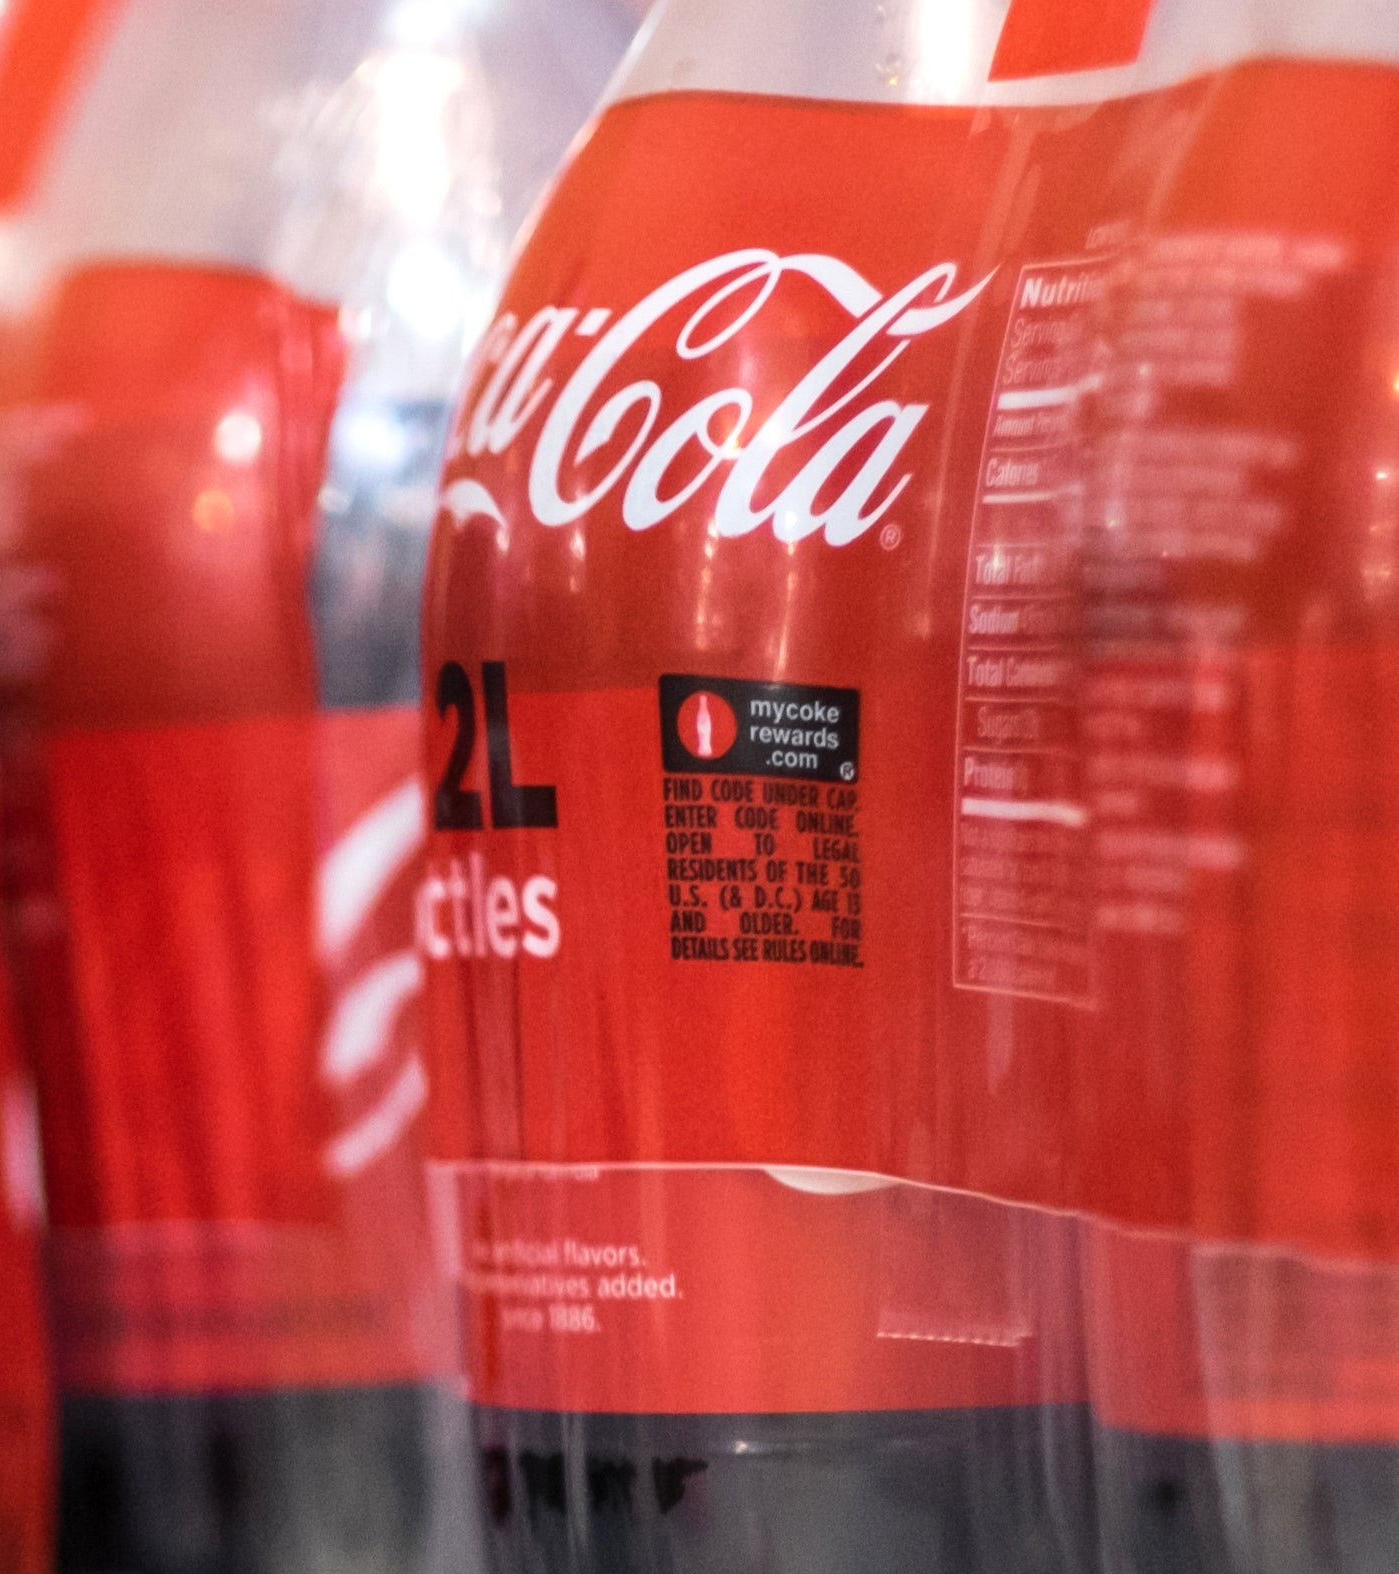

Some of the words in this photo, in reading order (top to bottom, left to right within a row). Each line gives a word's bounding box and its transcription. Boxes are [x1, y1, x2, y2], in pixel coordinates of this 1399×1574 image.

[749, 699, 841, 724] mycoke
[433, 659, 559, 833] 2L
[749, 725, 840, 750] rewards
[765, 750, 819, 770] .com
[663, 776, 703, 802] FIND
[710, 778, 756, 804] CODE
[761, 781, 821, 809] UNDER
[664, 803, 718, 830] ENTER
[734, 805, 781, 831] CODE
[665, 830, 714, 856] OPEN
[753, 832, 777, 857] TO
[812, 835, 862, 865] LEGAL
[667, 857, 758, 883] RESIDENTS
[765, 859, 789, 884] OF
[795, 861, 830, 887] THE
[668, 883, 709, 908] U.S.
[719, 885, 743, 912] (&
[753, 885, 803, 914] D.C.)
[810, 889, 839, 914] AGE
[670, 909, 707, 933] AND
[739, 911, 800, 936] OLDER.
[830, 915, 863, 941] FOR
[671, 936, 730, 962] DETAILS
[732, 937, 759, 962] SEE
[761, 939, 808, 964] RULES
[563, 1237, 647, 1267] flavors.
[598, 1273, 683, 1299] added.
